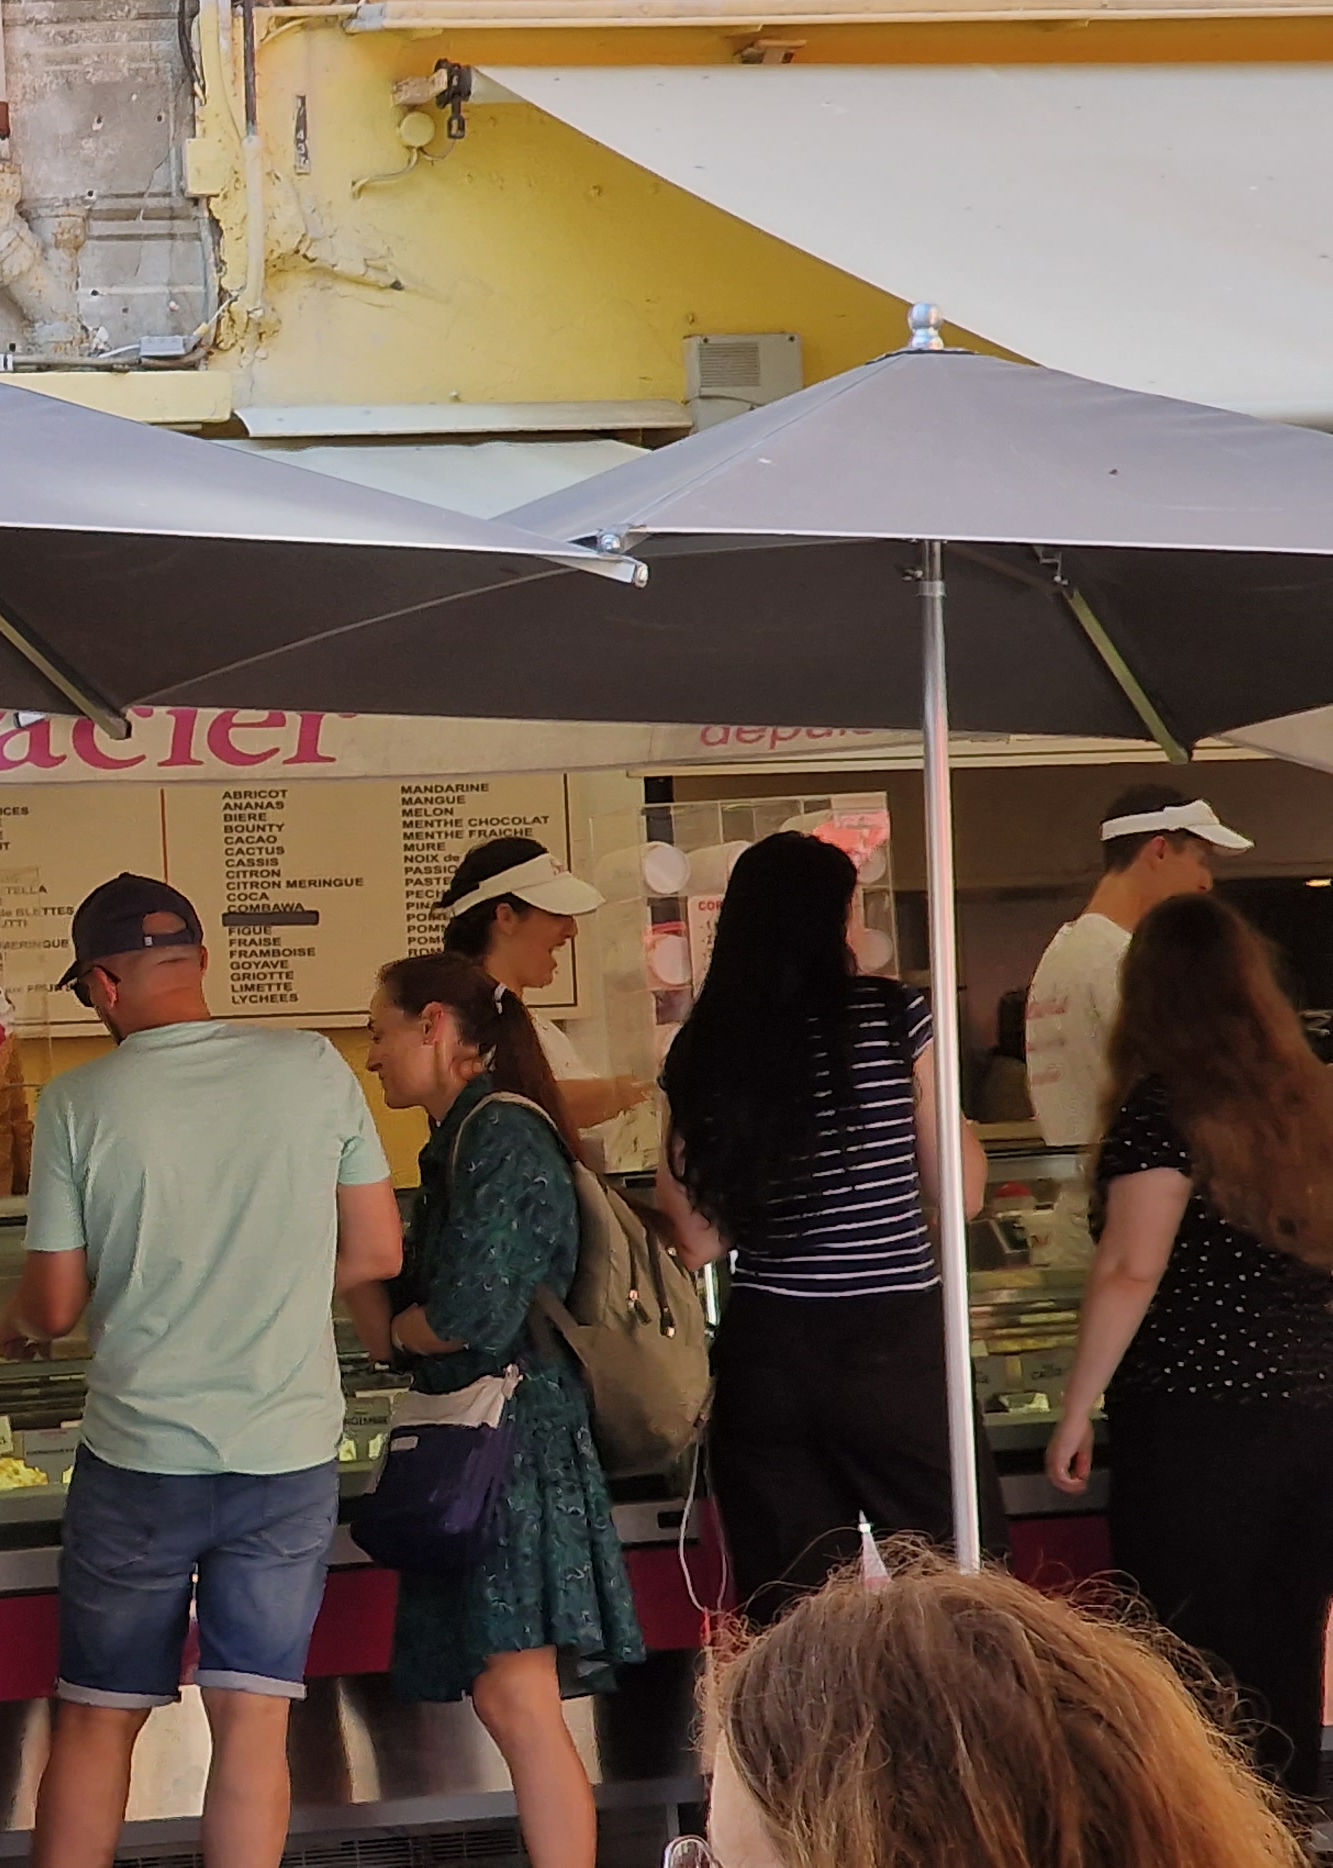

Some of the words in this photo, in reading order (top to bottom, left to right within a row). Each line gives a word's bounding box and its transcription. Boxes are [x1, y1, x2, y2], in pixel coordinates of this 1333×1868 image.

[401, 783, 490, 794] MANDARINE
[222, 789, 289, 800] ABRICOT
[222, 801, 285, 811] ANANAS
[401, 795, 467, 806] MANGUE
[223, 812, 267, 823] BIERE
[401, 807, 454, 818] MELON
[402, 818, 464, 829] MENTHE
[468, 815, 550, 828] CHOCOLAT
[223, 823, 285, 834] BOUNTY
[402, 829, 464, 840] MENTHE
[468, 827, 533, 839] FRAICHE
[224, 835, 278, 845] CACAO
[224, 846, 285, 857] CACTUS
[403, 842, 446, 852] MURE
[225, 858, 279, 868] CASSIS
[404, 854, 439, 864] NOIX
[443, 854, 460, 863] de
[225, 869, 281, 880] CITRON
[404, 865, 458, 875] PASSIO
[226, 880, 282, 891] CITRON
[285, 877, 364, 889] MERINGUE
[405, 877, 451, 887] PASTE
[226, 892, 270, 903] COCA
[405, 889, 443, 899] PECH
[227, 903, 305, 913] COMBAWA
[228, 926, 273, 936] FIGUE
[228, 937, 282, 948] FRAISE
[229, 947, 316, 959] FRAMBOISE
[230, 960, 289, 971] GOYAVE
[230, 971, 294, 982] GRIOTTE
[230, 982, 293, 993] LIMETTE
[231, 993, 299, 1005] LYCHEES
